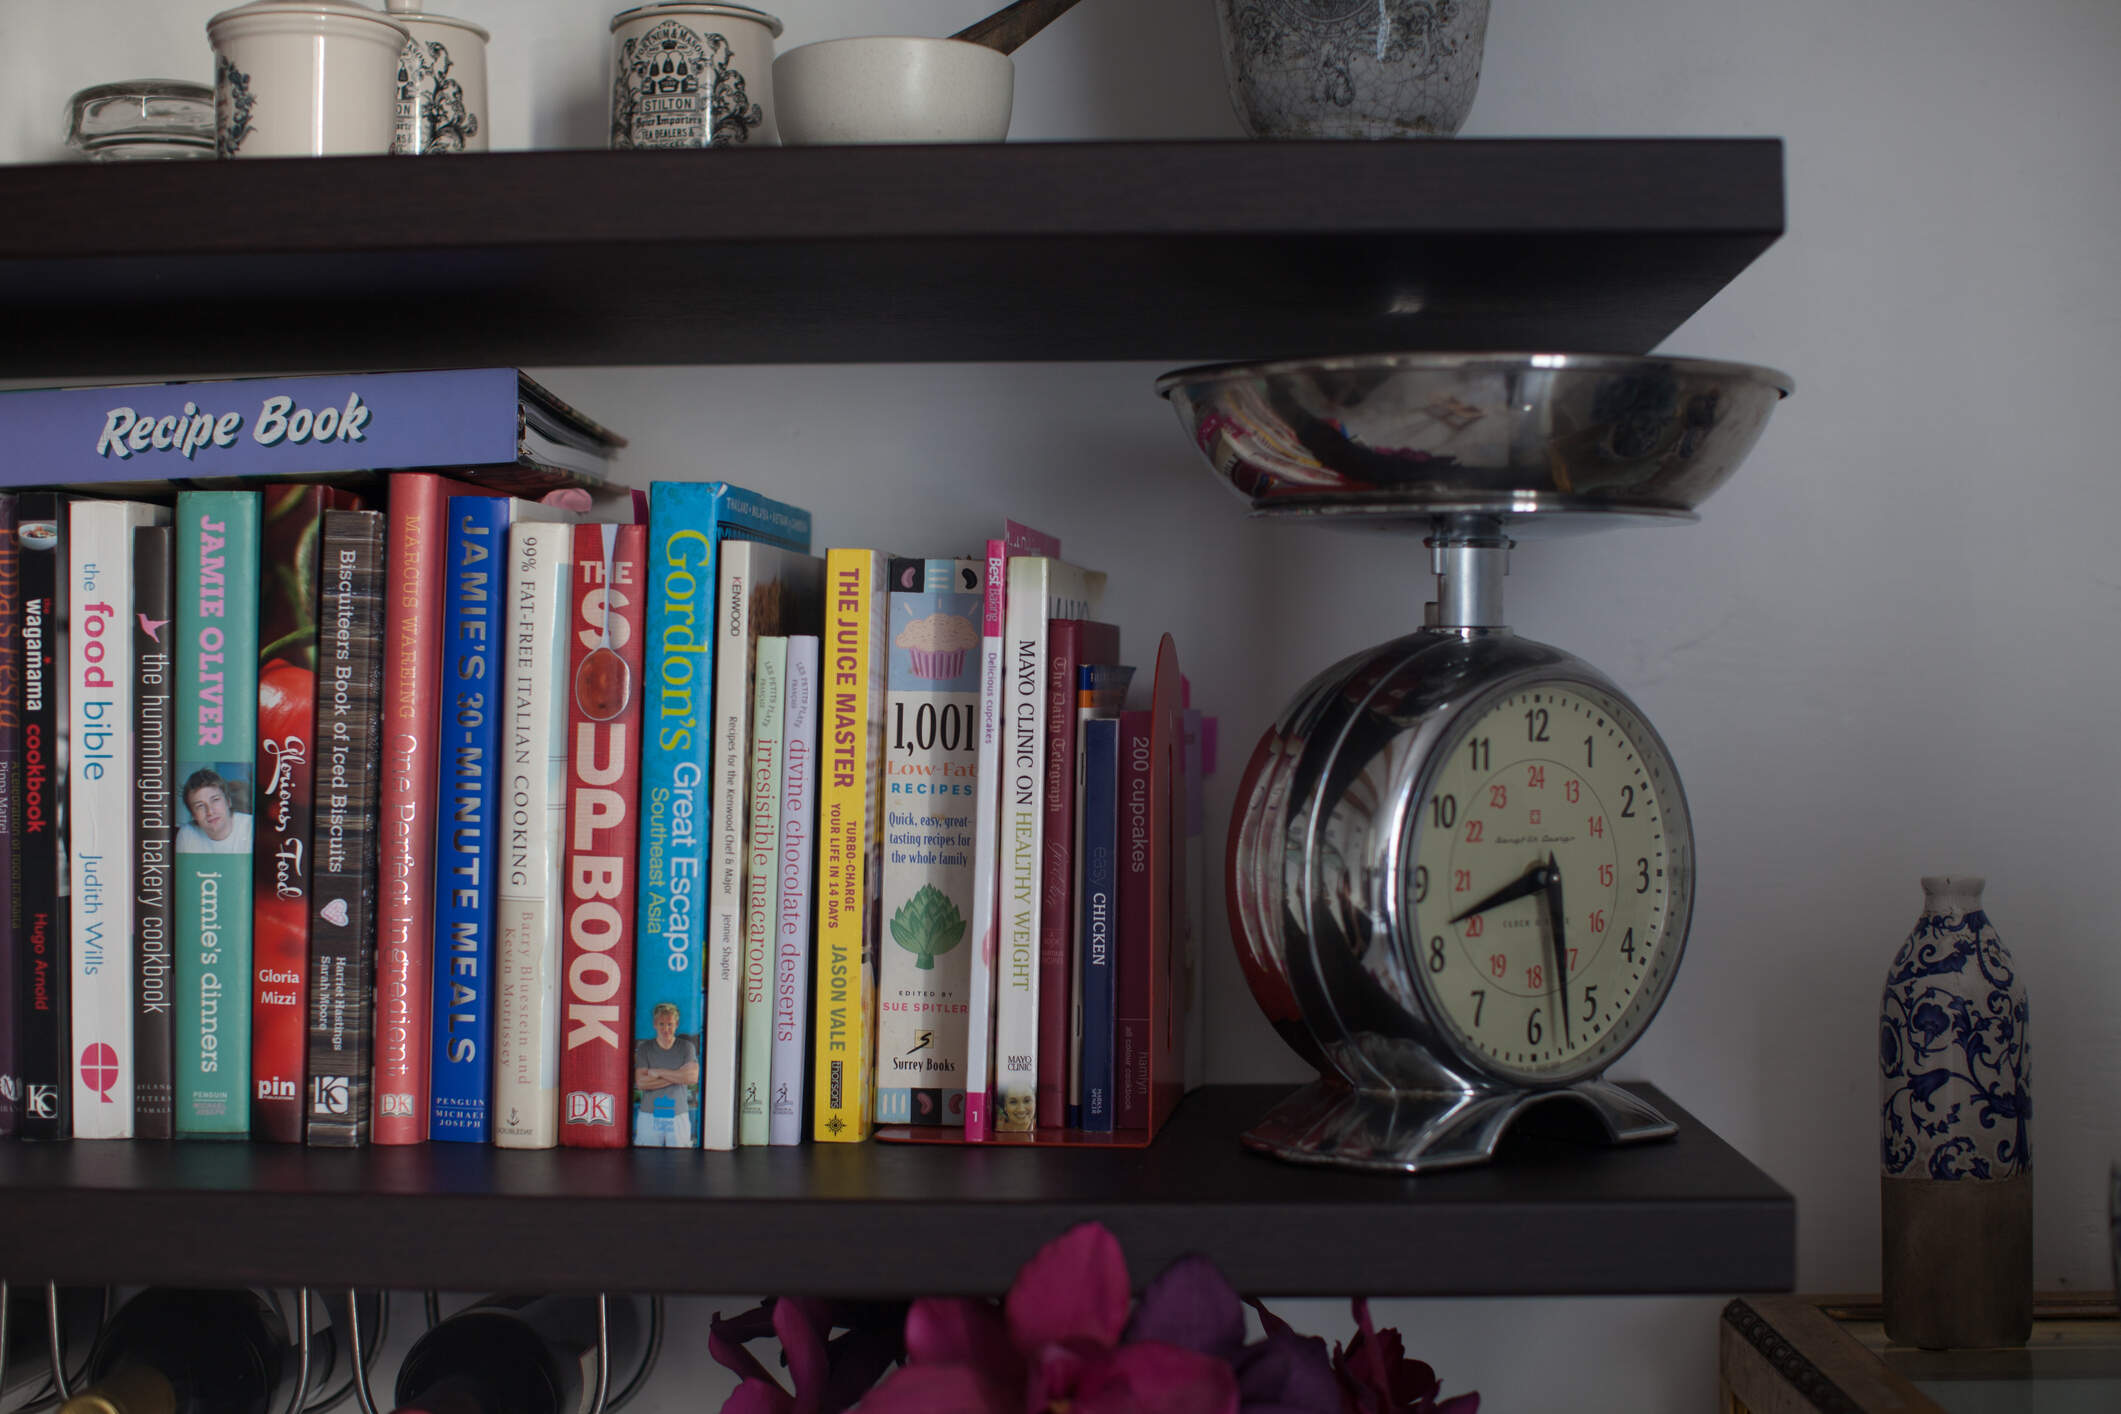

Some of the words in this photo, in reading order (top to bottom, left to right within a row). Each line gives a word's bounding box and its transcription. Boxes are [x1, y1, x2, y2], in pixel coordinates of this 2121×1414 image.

[644, 98, 692, 112] STILTON
[96, 400, 245, 462] Recipe
[252, 391, 372, 449] Book
[200, 514, 225, 617] JAMIE
[401, 515, 421, 609] MARCUS
[521, 537, 538, 572] 99%
[580, 559, 633, 584] THE
[987, 557, 1002, 586] Best
[84, 563, 100, 591] the
[458, 515, 490, 680] JAMIE'S
[838, 567, 860, 612] THE
[336, 549, 357, 660] Biscuiteers
[730, 576, 742, 637] KENWOOD
[985, 585, 999, 622] Baking
[84, 601, 114, 688] food
[518, 581, 536, 669] FAT-FREE
[659, 529, 711, 751] Gordon's
[22, 599, 43, 711] wagamama
[142, 652, 170, 685] the
[400, 617, 418, 718] WAREING
[836, 618, 859, 686] JUICE
[1018, 640, 1036, 696] MAYO
[1052, 656, 1068, 689] The
[198, 626, 224, 747] OLIVER
[333, 665, 353, 716] Book
[986, 652, 997, 700] Delicious
[332, 721, 351, 742] of
[514, 677, 533, 764] ITALIAN
[727, 716, 739, 752] Recipes
[893, 702, 975, 757] 1,001
[984, 701, 995, 745] cupcakes
[1049, 692, 1067, 734] Daily
[1524, 708, 1550, 742] 12
[84, 701, 114, 781] bible
[833, 693, 857, 788] MASTER
[1016, 703, 1035, 768] CLINIC
[1132, 736, 1150, 773] 200
[1469, 737, 1490, 770] 11
[1584, 735, 1593, 768] 1
[26, 723, 46, 833] cookbook
[138, 695, 170, 829] hummingbird
[330, 746, 349, 788] Iced
[392, 734, 418, 793] One
[726, 770, 738, 784] the
[728, 754, 738, 767] for
[786, 739, 811, 811] divine
[888, 760, 976, 777] Low-Fat
[1047, 737, 1066, 812] Telegraph
[1527, 765, 1545, 789] 24
[264, 735, 306, 832] Glorious
[452, 691, 484, 909] 30-MINUTE
[671, 762, 702, 847] Great
[751, 739, 778, 866] irresistible
[891, 783, 973, 796] RECIPES
[1015, 776, 1034, 806] ON
[1490, 784, 1507, 809] 23
[1564, 780, 1580, 804] 13
[1621, 785, 1635, 818] 2
[511, 775, 530, 887] COOKING
[725, 788, 737, 832] Kenwood
[828, 803, 841, 834] YOUR
[888, 811, 917, 828] Quick,
[920, 816, 943, 829] easy,
[1128, 778, 1149, 873] cupcakes
[1429, 794, 1457, 829] 10
[1588, 815, 1603, 838] 14
[328, 794, 348, 873] Biscuits
[388, 799, 417, 906] Perfect
[648, 786, 670, 887] Southeast
[724, 834, 735, 855] Chef
[828, 837, 841, 863] LIFE
[889, 832, 921, 848] tasting
[923, 833, 955, 849] recipes
[957, 834, 971, 847] for
[1465, 820, 1483, 843] 22
[137, 839, 170, 907] bakery
[275, 837, 303, 900] Food
[781, 820, 807, 934] chocolate
[828, 865, 840, 874] IN
[844, 820, 857, 912] TURBO-CHARGE
[891, 851, 906, 864] the
[907, 852, 936, 865] whole
[938, 853, 968, 867] family
[1013, 812, 1033, 907] HEALTHY
[1598, 864, 1613, 887] 15
[1636, 857, 1650, 894] 3
[79, 853, 104, 914] Judith
[721, 868, 734, 896] Major
[828, 882, 840, 896] 14
[1415, 865, 1429, 903] 9
[1454, 870, 1471, 892] 21
[32, 913, 48, 955] Hugo
[197, 871, 222, 964] jamie's
[518, 911, 534, 956] Barry
[647, 892, 667, 934] Asia
[661, 857, 698, 972] Escape
[721, 914, 733, 943] Jennie
[827, 900, 840, 929] DAYS
[1091, 891, 1107, 966] CHICKEN
[1465, 915, 1484, 938] 20
[1589, 909, 1605, 933] 16
[84, 922, 104, 975] Wills
[503, 927, 515, 975] Kevin
[567, 854, 626, 1051] BOOK
[746, 874, 770, 1004] macaroons
[1012, 911, 1032, 992] WEIGHT
[1429, 936, 1445, 973] 8
[1620, 927, 1635, 963] 4
[142, 916, 171, 1014] cookbook
[259, 968, 300, 984] Gloria
[320, 955, 333, 989] Sarah
[334, 956, 348, 997] Harriet
[719, 946, 732, 982] Shapter
[830, 944, 848, 1002] JASON
[1490, 954, 1507, 978] 19
[1527, 964, 1542, 989] 18
[34, 960, 48, 1011] Arnold
[261, 991, 297, 1005] Mizzi
[386, 914, 414, 1077] Ingredient
[447, 921, 479, 1064] MEALS
[518, 966, 531, 1046] Bluestein
[777, 943, 802, 1042] desserts
[898, 990, 936, 998] EDITED
[941, 991, 953, 999] BY
[1582, 984, 1597, 1022] 5
[200, 972, 222, 1073] dinners
[319, 993, 332, 1030] Moore
[331, 998, 346, 1050] Hastings
[500, 984, 515, 1067] Morrissey
[882, 1002, 909, 1012] SUE
[913, 1002, 969, 1014] SPITLER
[1470, 990, 1485, 1027] 7
[1527, 1008, 1541, 1046] 6
[829, 1008, 847, 1052] VALE
[518, 1054, 531, 1085] and
[892, 1056, 924, 1072] Surrey
[926, 1058, 956, 1072] Books
[1007, 1055, 1033, 1064] MAYO
[1007, 1063, 1033, 1072] CLINIC
[1135, 1050, 1150, 1095] hamlyn
[258, 1076, 296, 1099] pin
[436, 1097, 486, 1106] PENGUIN
[570, 1093, 609, 1119] DK
[830, 1061, 842, 1109] thorsons
[436, 1110, 486, 1118] MICHAEL
[440, 1119, 482, 1128] JOSEPH
